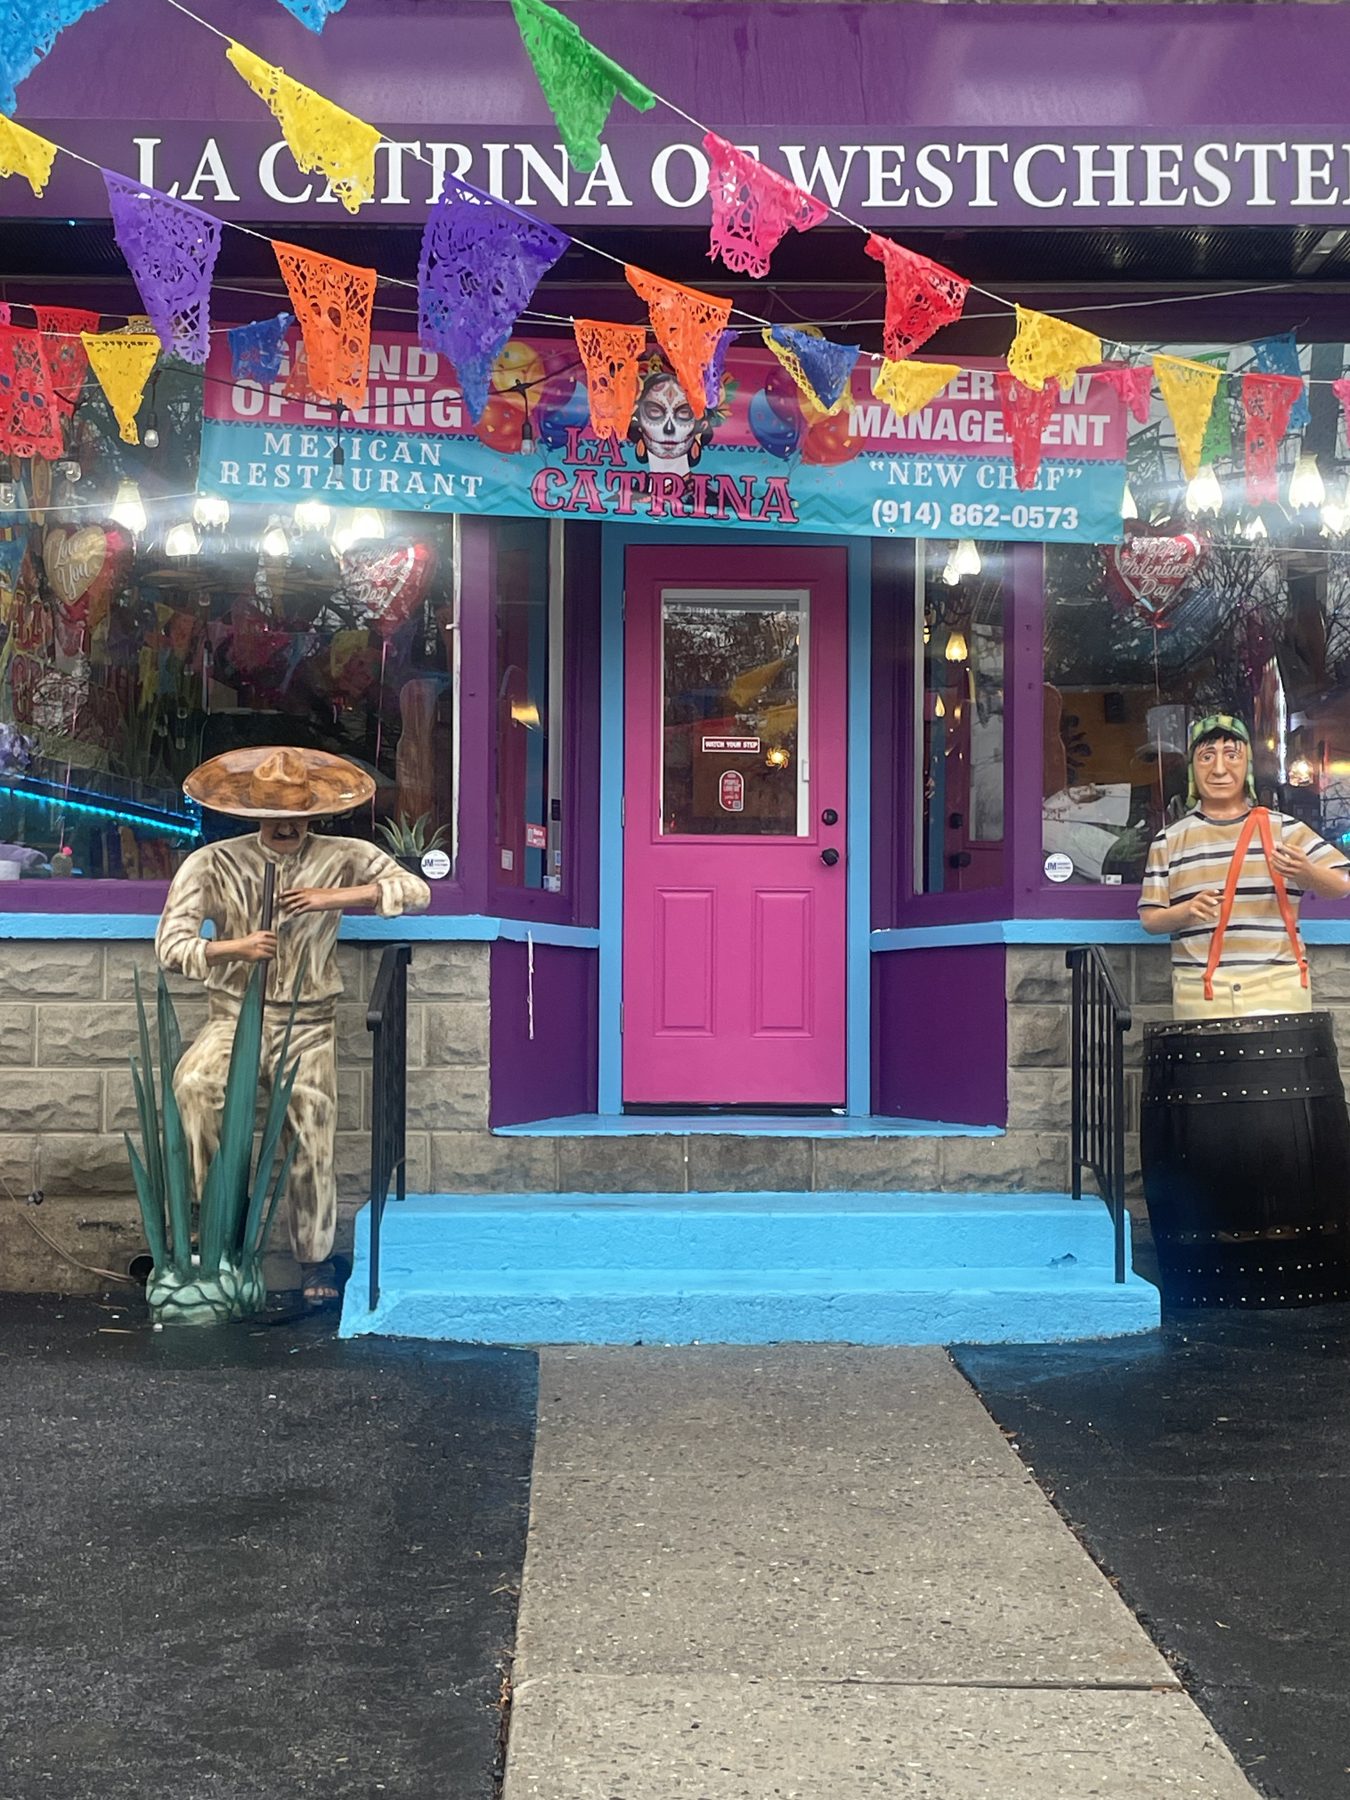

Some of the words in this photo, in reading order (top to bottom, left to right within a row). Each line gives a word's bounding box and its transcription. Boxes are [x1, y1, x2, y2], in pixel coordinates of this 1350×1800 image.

[133, 138, 240, 201] LA
[651, 143, 760, 208] O
[779, 142, 1350, 208] WESTCHESTE
[848, 405, 1111, 447] MANAGEENT
[262, 432, 442, 467] MEXICAN
[563, 426, 627, 467] LA
[218, 460, 483, 497] RESTAURANT
[530, 467, 800, 523] CATRINA
[872, 500, 941, 529] (914)
[950, 504, 1079, 530] 862-0573
[57, 561, 90, 600] You
[1141, 576, 1174, 603] Day
